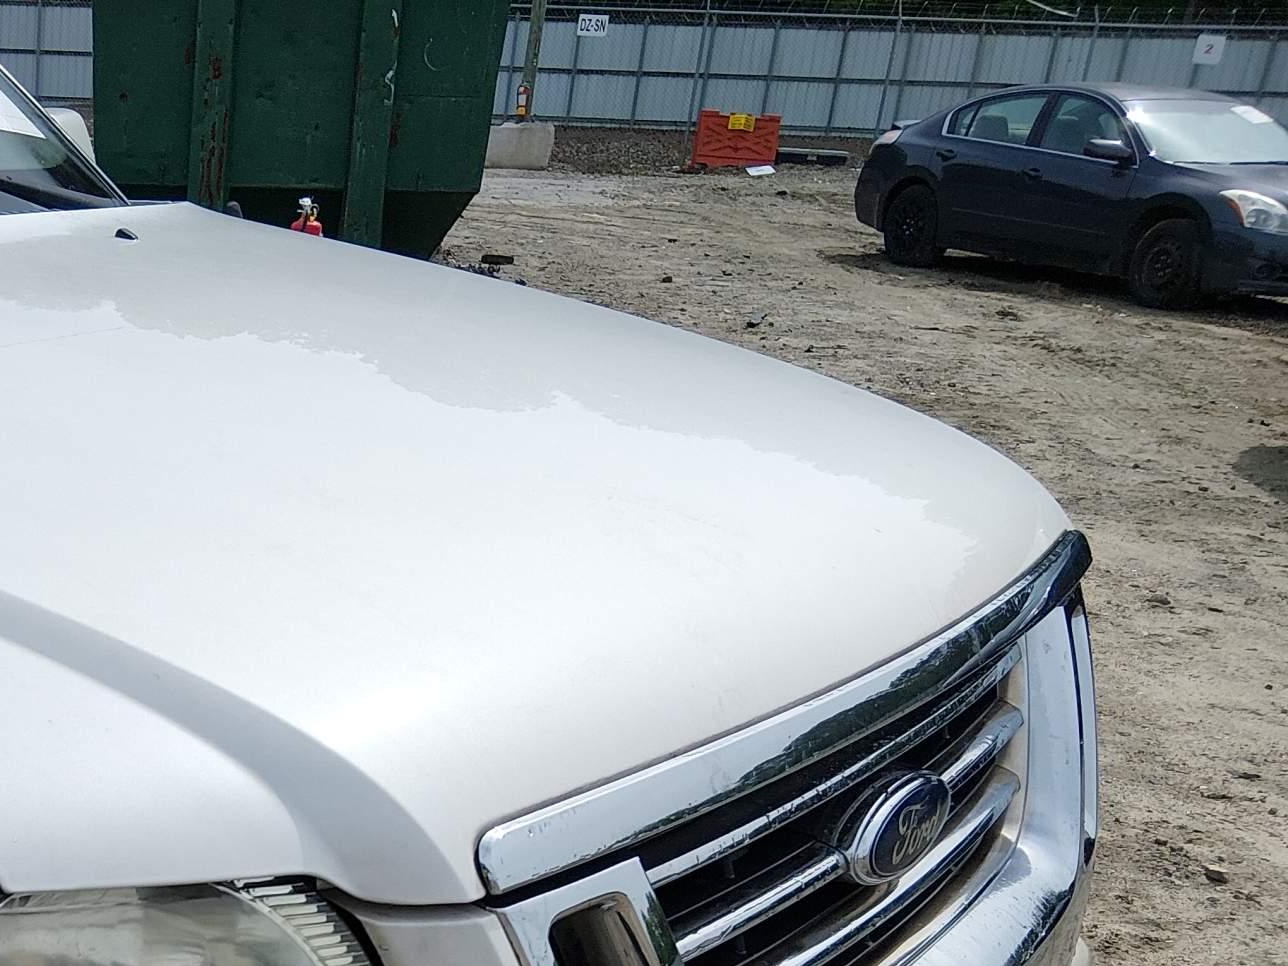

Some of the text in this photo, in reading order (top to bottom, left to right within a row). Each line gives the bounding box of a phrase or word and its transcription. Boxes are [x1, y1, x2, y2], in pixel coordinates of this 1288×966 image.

[579, 18, 607, 32] DZ-SN
[1203, 43, 1214, 54] 2
[892, 799, 937, 865] Ford
